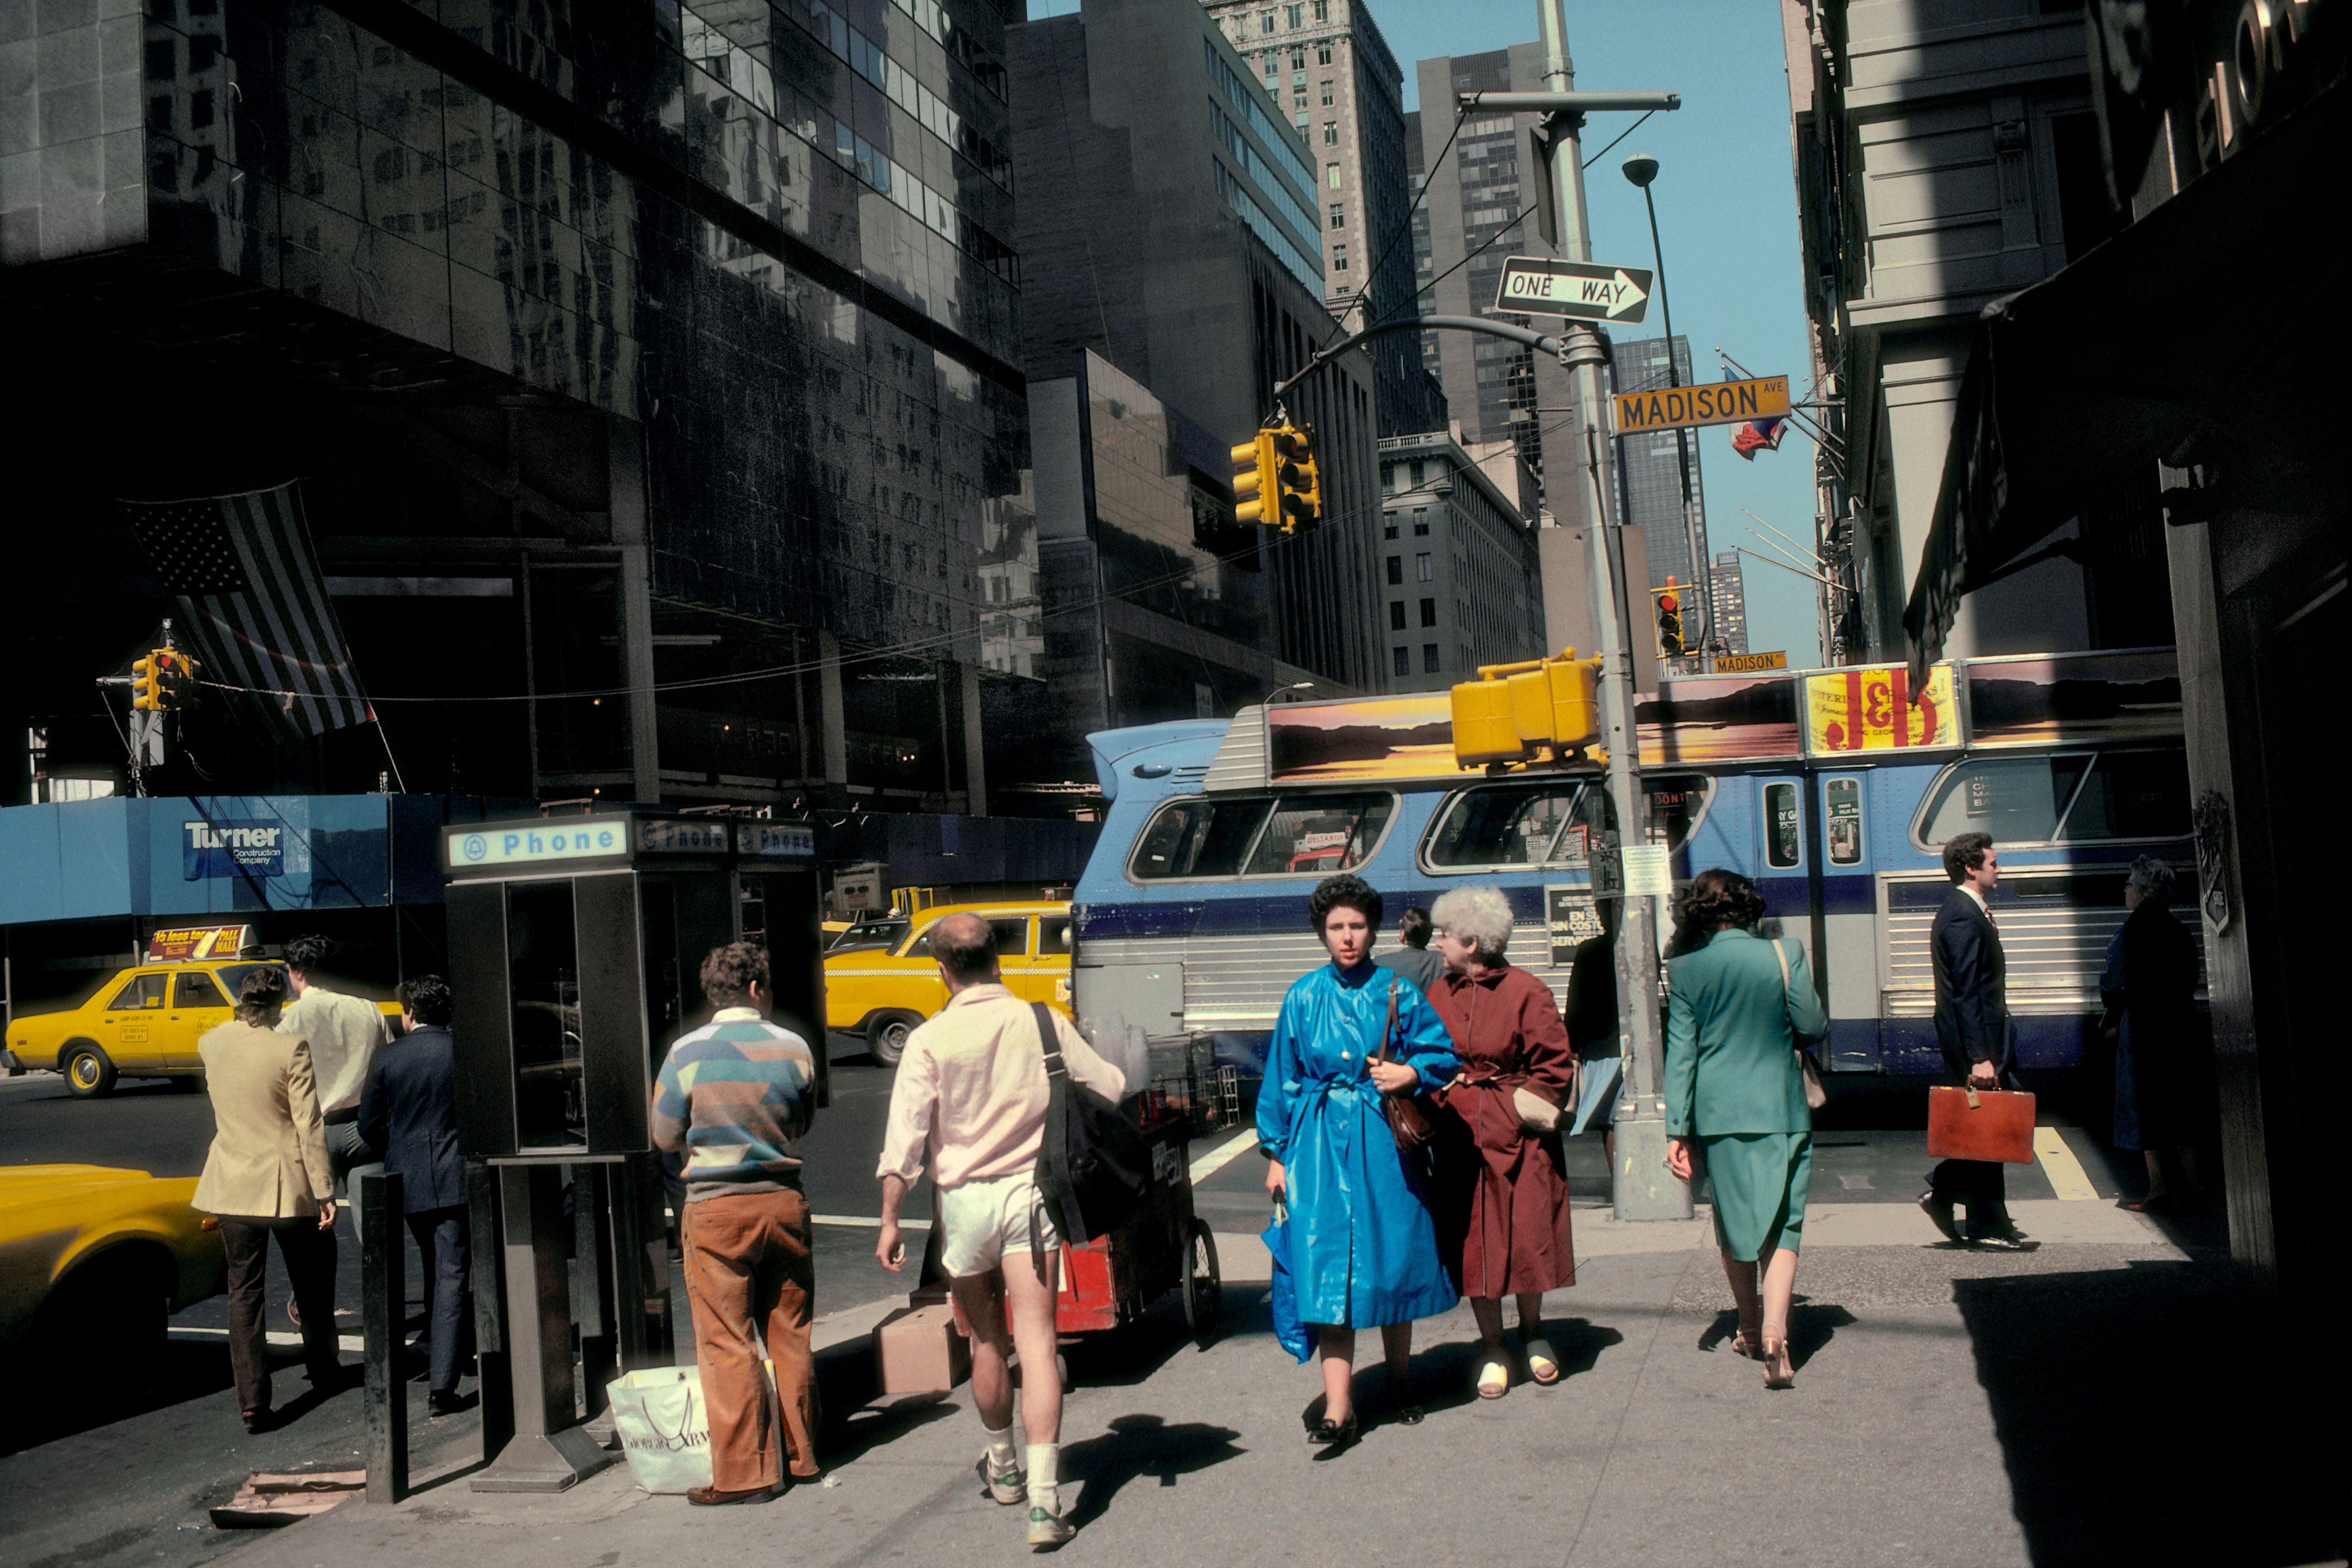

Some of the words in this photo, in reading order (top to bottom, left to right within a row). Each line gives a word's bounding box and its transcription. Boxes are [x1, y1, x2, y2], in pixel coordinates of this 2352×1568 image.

[1513, 275, 1553, 297] ONE
[1582, 280, 1627, 304] WAY
[1623, 384, 1758, 427] MADISON
[1764, 381, 1783, 393] AVE
[1718, 655, 1773, 673] MADISON
[1654, 793, 1684, 805] DONT
[185, 822, 280, 849] Turner
[504, 831, 614, 856] Phone
[233, 849, 281, 857] Construction
[234, 857, 271, 865] Company
[1569, 911, 1585, 921] EN
[1551, 921, 1568, 931] SIN
[167, 931, 190, 942] less
[190, 930, 206, 940] tar
[219, 930, 239, 942] PALL
[215, 941, 237, 953] MALL
[680, 1430, 711, 1447] ARM
